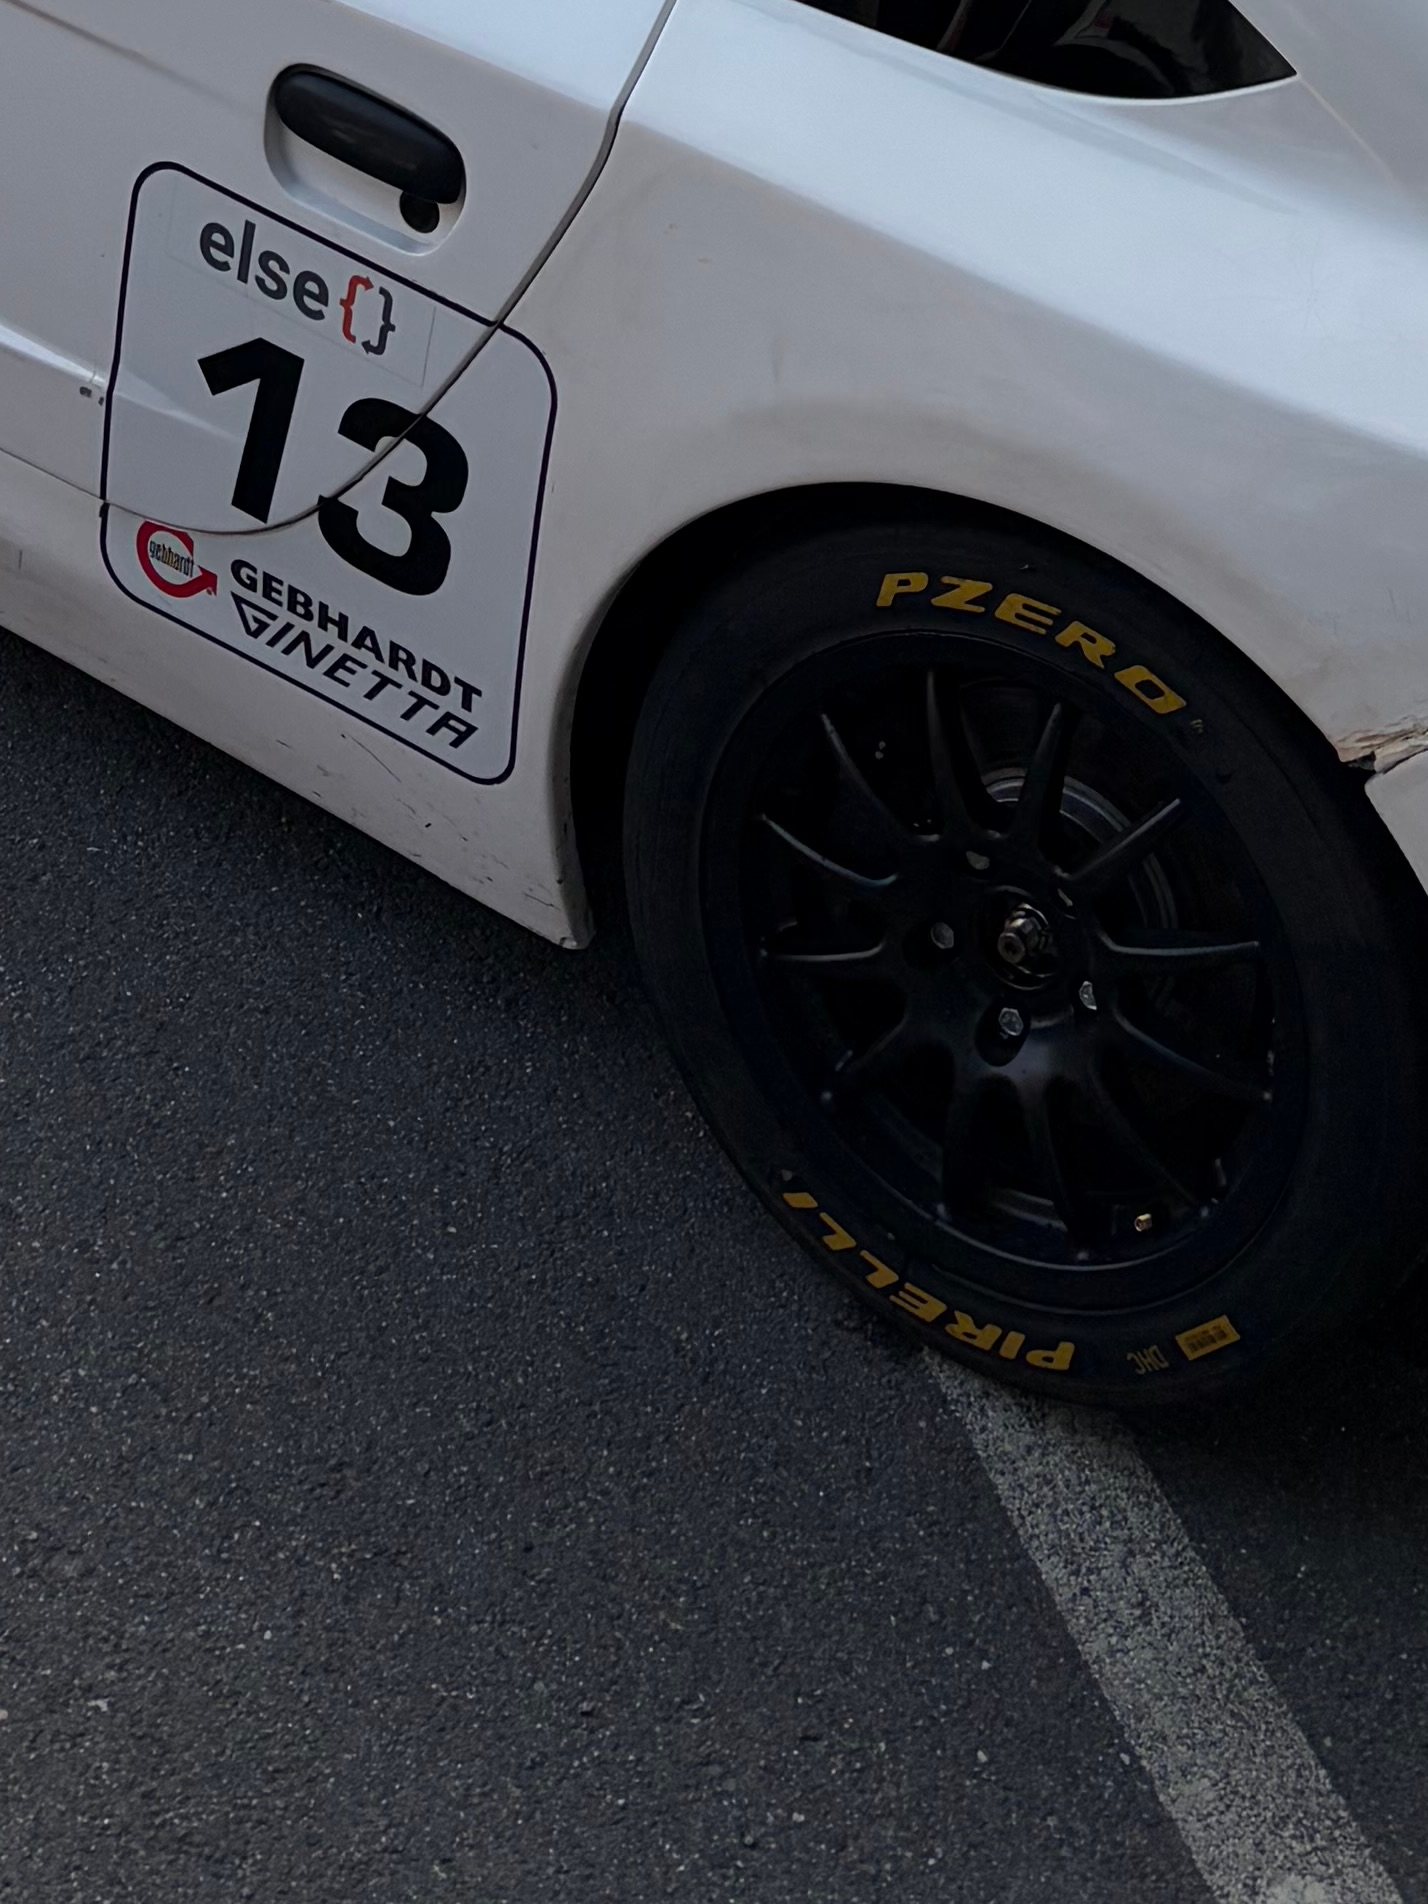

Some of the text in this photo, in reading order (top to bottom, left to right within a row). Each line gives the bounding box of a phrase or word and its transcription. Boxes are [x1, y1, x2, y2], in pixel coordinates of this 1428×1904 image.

[197, 337, 469, 596] 13
[149, 539, 195, 578] gebhardt
[230, 558, 483, 713] GEBHARDT
[230, 590, 479, 749] GINETTA
[782, 1191, 1075, 1372] PIRELLI
